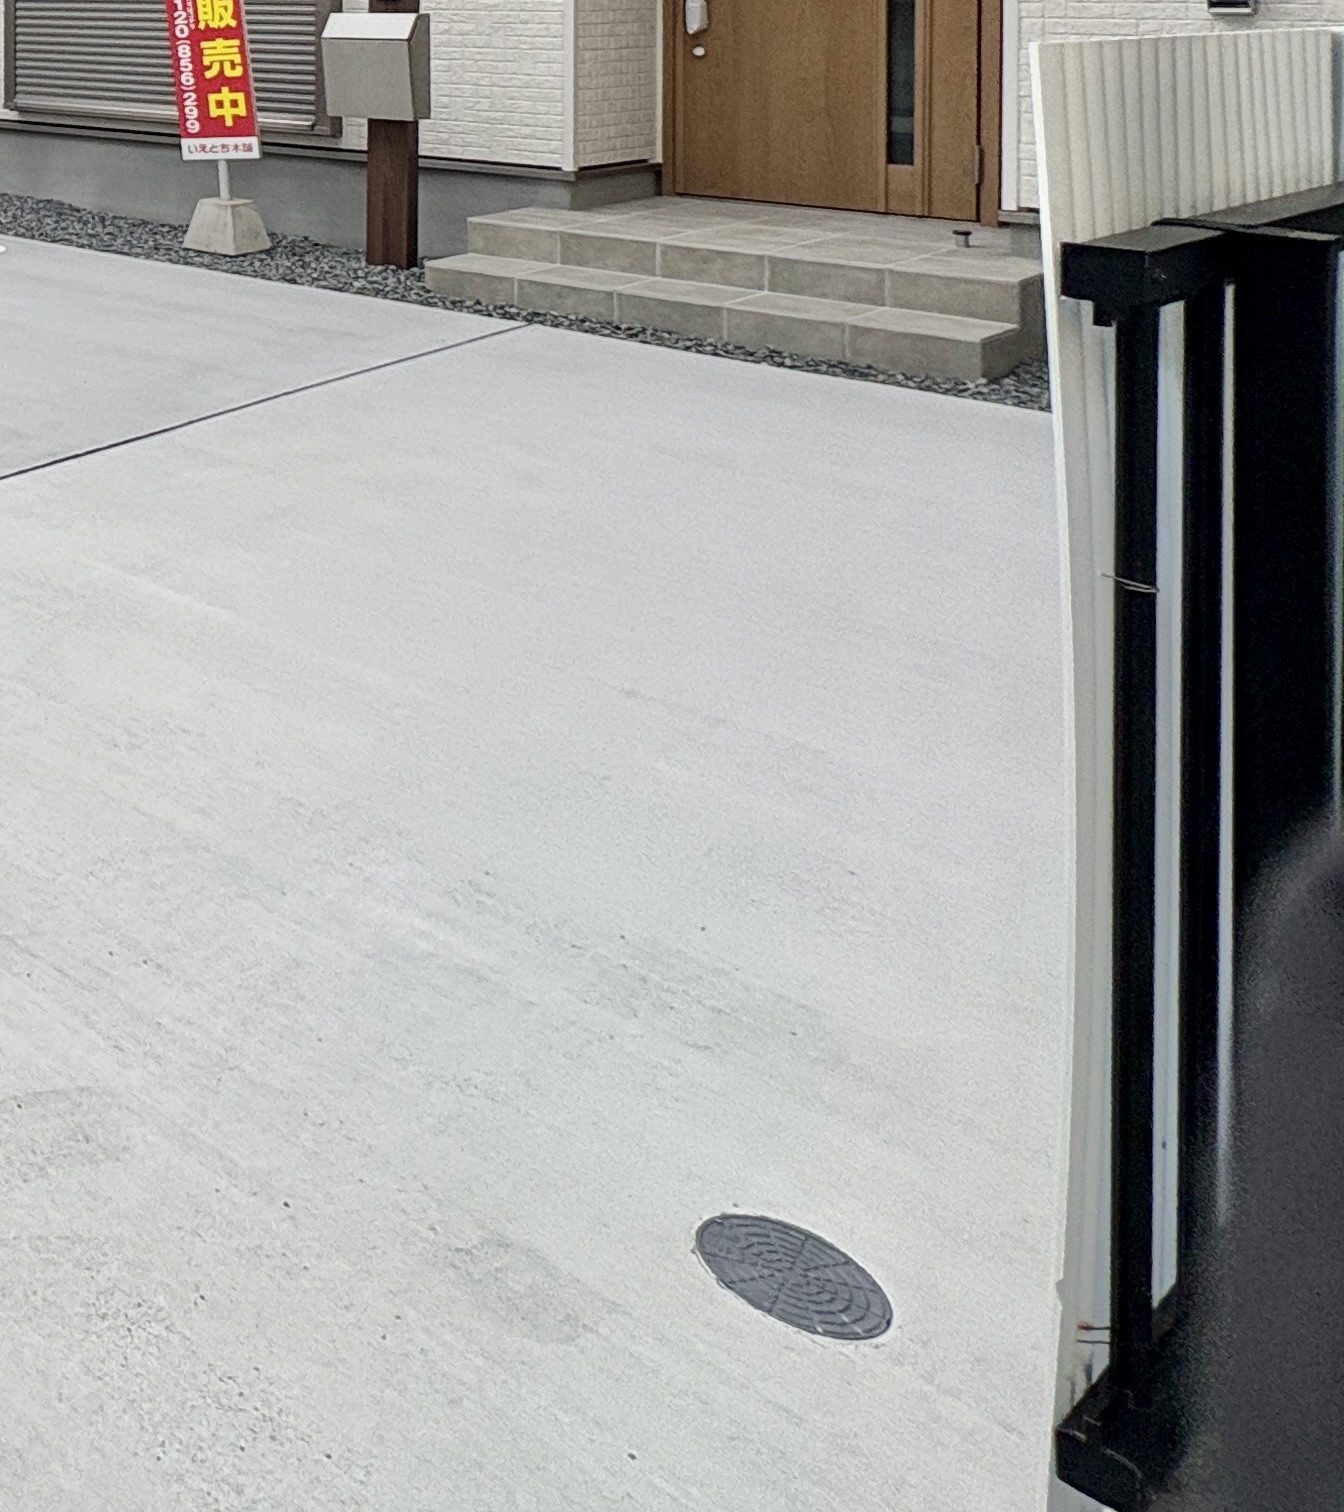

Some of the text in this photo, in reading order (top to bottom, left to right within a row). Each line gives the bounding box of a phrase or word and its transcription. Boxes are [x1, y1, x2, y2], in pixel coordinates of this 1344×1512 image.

[187, 142, 254, 154] いえとち本舗
